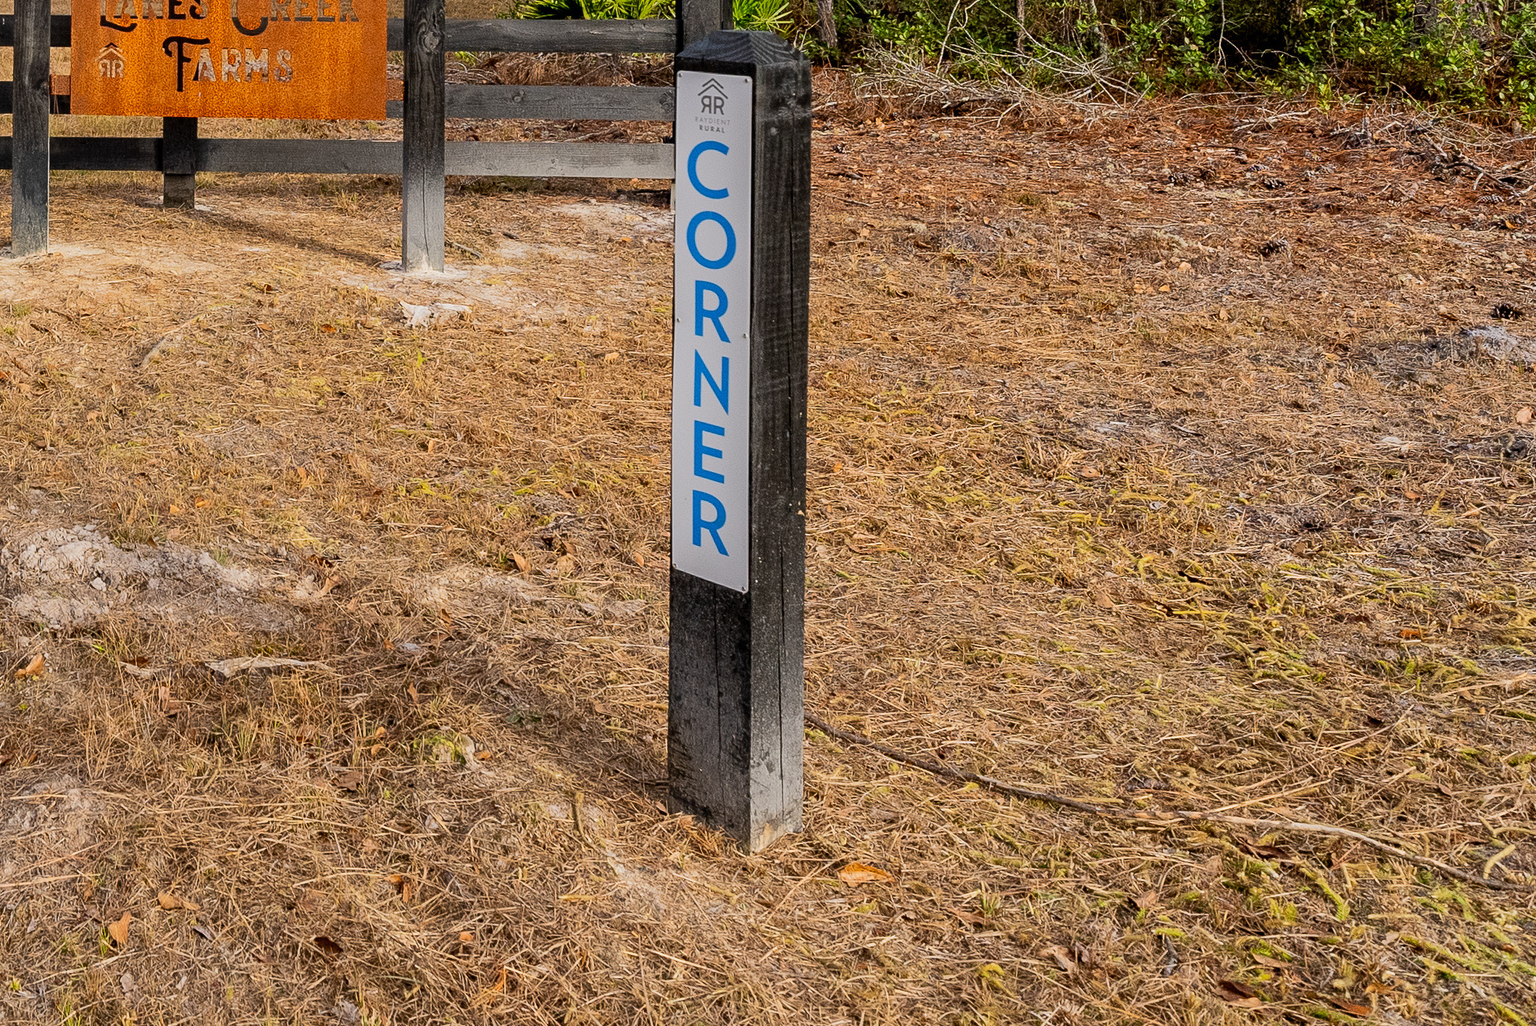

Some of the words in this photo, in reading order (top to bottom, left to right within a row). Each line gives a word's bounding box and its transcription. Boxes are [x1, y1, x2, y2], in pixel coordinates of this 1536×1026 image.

[163, 36, 293, 92] FARMS
[699, 124, 726, 134] RURAL
[686, 140, 737, 557] CORNER
